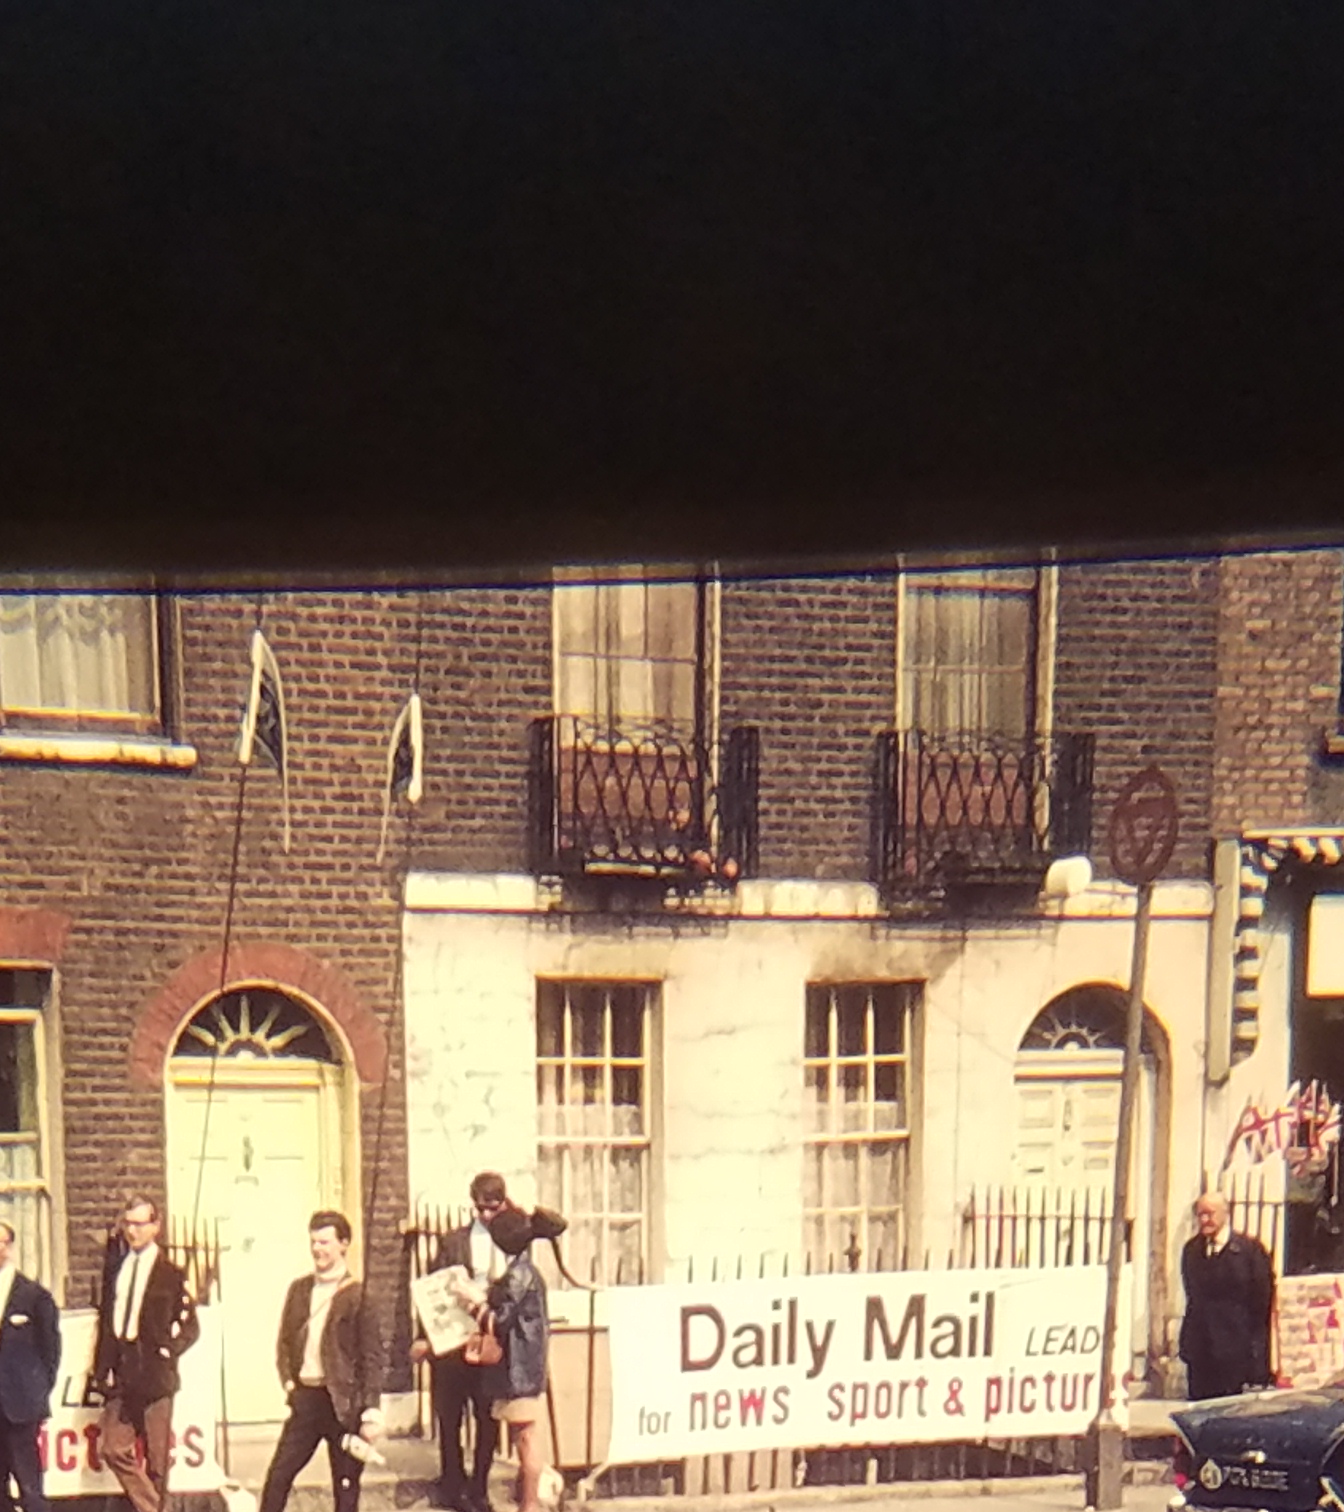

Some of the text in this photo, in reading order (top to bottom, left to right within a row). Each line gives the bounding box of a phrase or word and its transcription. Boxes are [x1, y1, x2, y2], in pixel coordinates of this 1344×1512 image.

[680, 1297, 836, 1380] Daily
[863, 1291, 995, 1361] Mail
[638, 1406, 672, 1436] for
[690, 1385, 791, 1433] news
[827, 1376, 928, 1428] sport
[943, 1377, 966, 1417] &
